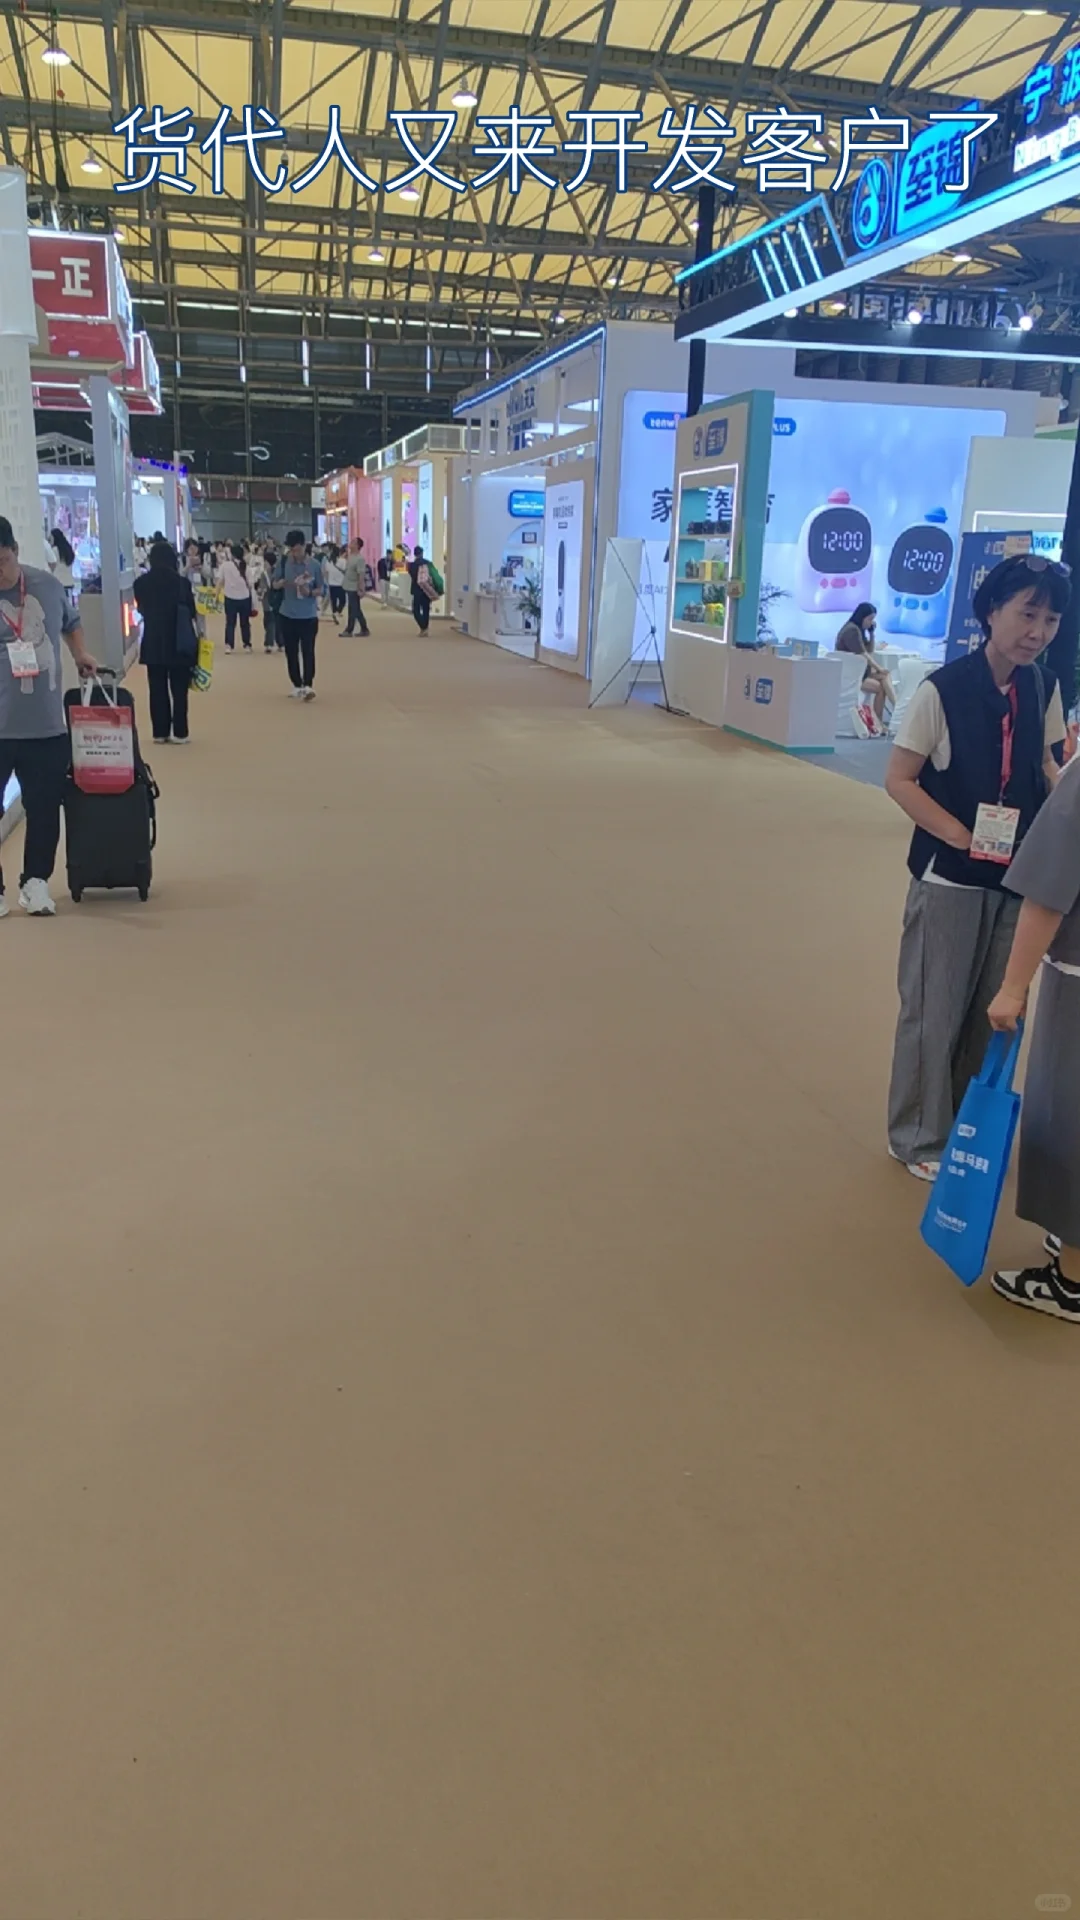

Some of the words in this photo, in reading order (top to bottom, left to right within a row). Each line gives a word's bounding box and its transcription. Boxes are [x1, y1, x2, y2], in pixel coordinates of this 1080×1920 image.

[772, 422, 791, 432] LUS
[823, 531, 863, 551] 12:00
[903, 549, 945, 573] 12:00
